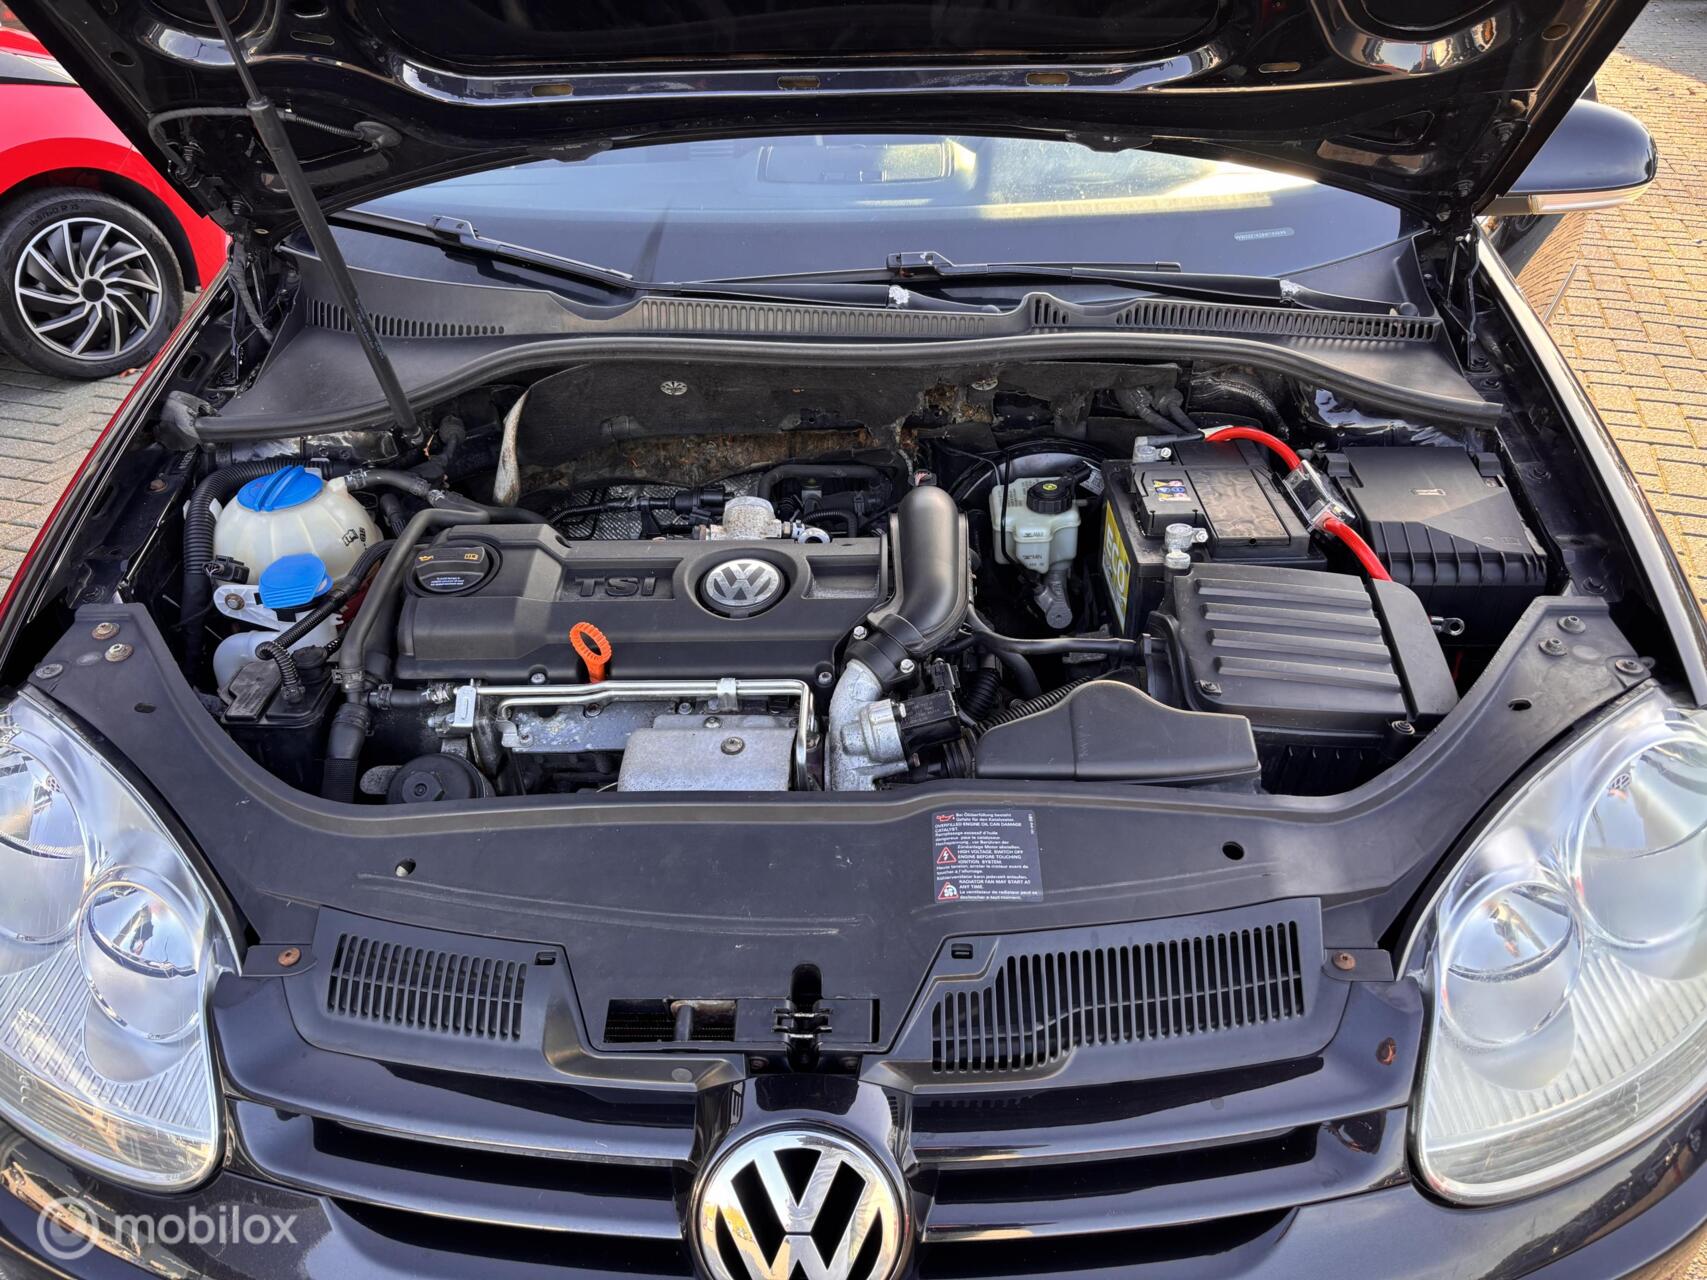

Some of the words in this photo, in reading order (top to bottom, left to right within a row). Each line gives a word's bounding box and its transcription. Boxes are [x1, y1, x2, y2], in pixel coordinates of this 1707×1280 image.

[575, 577, 656, 597] TSI
[706, 558, 780, 607] VW
[702, 1132, 898, 1280] VW
